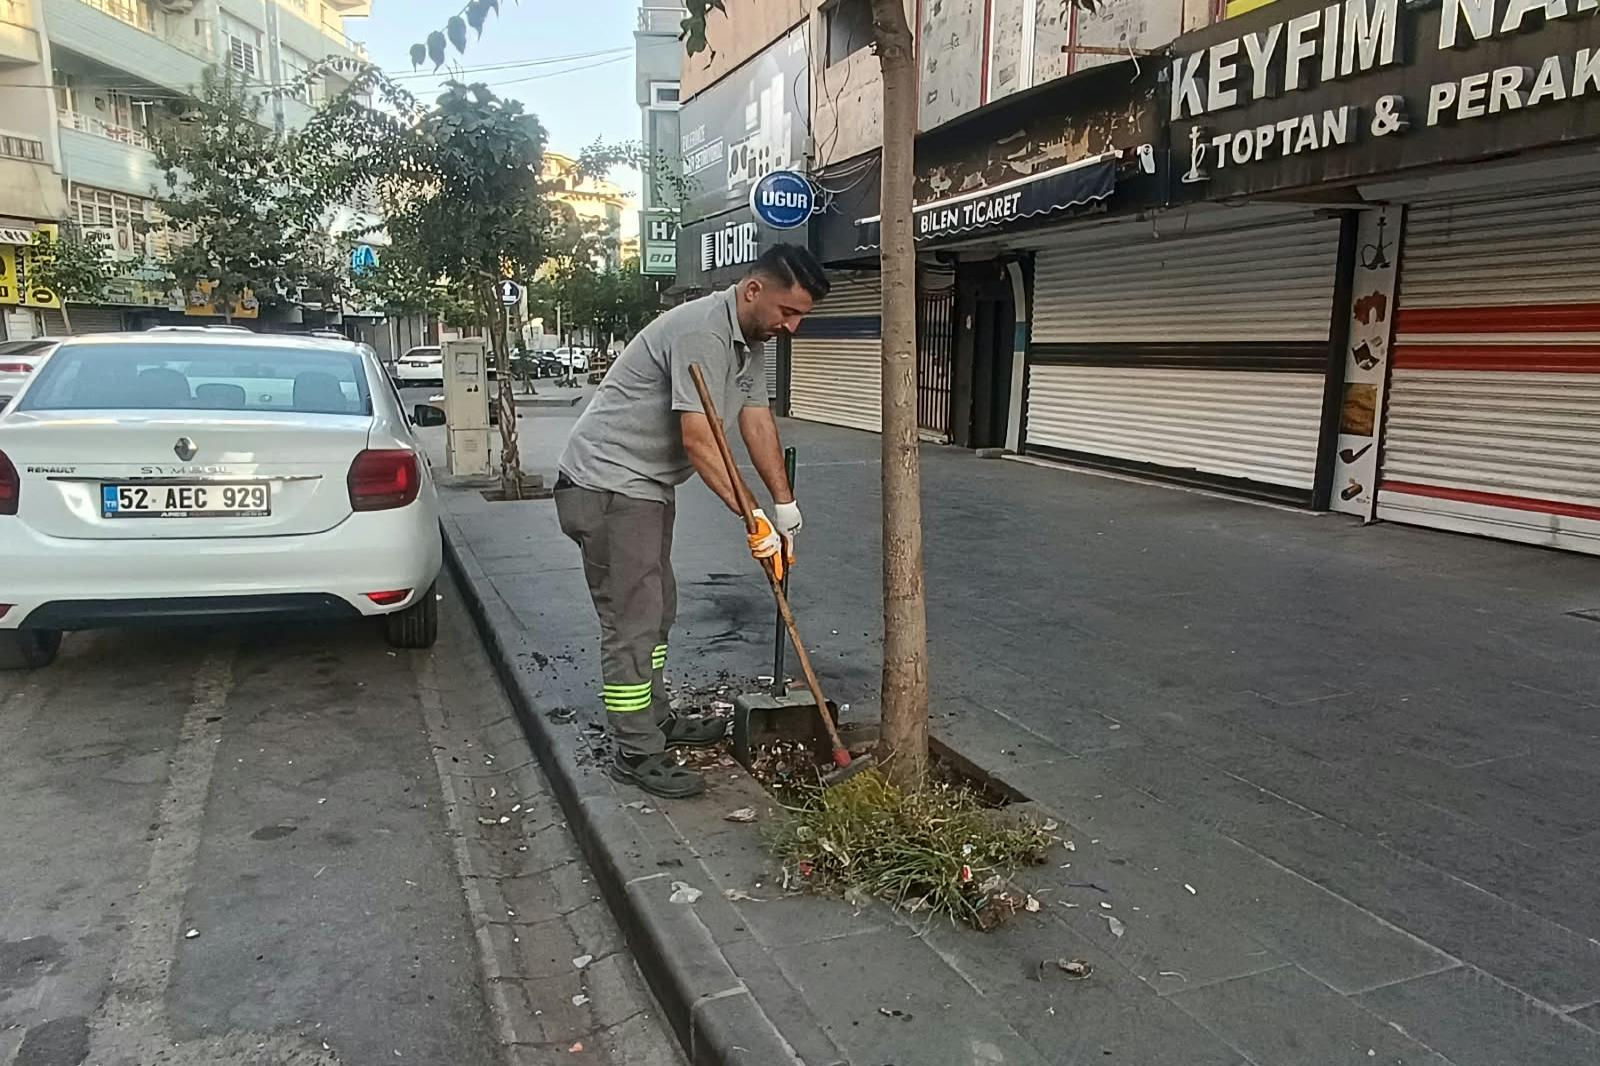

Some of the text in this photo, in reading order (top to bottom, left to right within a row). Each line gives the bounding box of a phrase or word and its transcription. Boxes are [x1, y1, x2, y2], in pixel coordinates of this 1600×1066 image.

[1212, 106, 1348, 168] TOPTAN
[1371, 95, 1400, 136] &
[120, 487, 265, 509] 52 AEC 929
